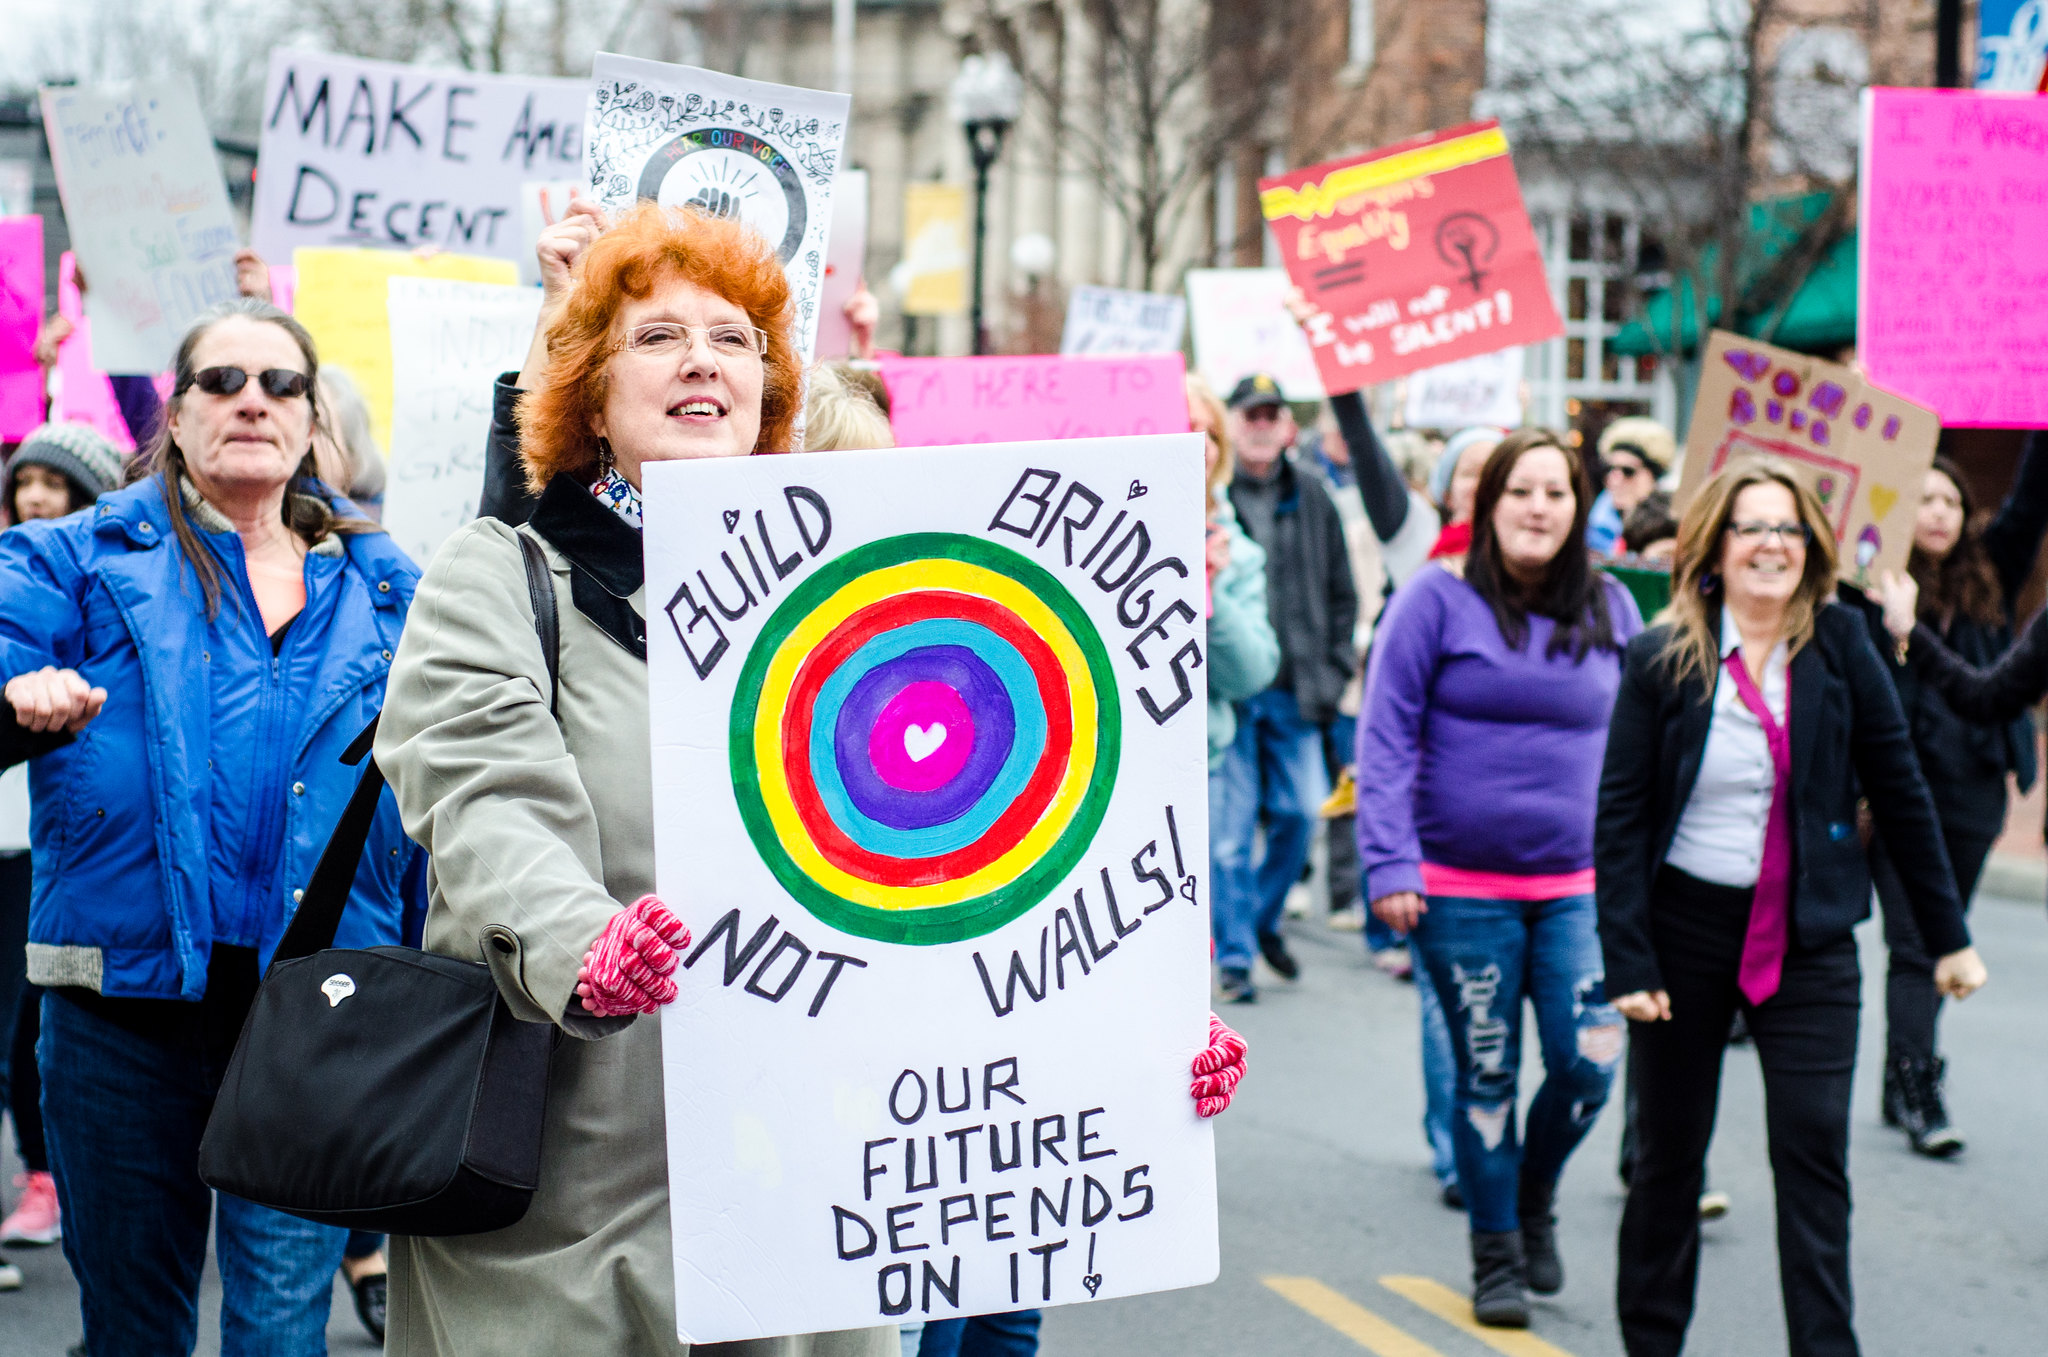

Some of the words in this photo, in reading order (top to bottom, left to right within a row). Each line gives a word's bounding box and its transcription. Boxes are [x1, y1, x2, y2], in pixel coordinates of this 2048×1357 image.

[269, 68, 478, 162] MAKE
[664, 132, 705, 161] HEAR
[710, 129, 745, 150] OUR
[751, 139, 789, 177] VOICE
[286, 164, 509, 247] DECENT
[1297, 207, 1411, 264] Equality
[1305, 312, 1338, 348] I
[1344, 299, 1401, 335] will
[1407, 284, 1450, 315] not
[1334, 339, 1375, 367] be
[1389, 288, 1514, 356] SILENT!
[972, 364, 1067, 409] HERE
[1102, 364, 1154, 398] TO
[683, 907, 868, 1018] NOT
[972, 805, 1198, 1018] WALLS!
[888, 1056, 1027, 1126] OUR
[863, 1106, 1119, 1201] FUTURE
[831, 1164, 1154, 1262] DEPENDS
[877, 1254, 961, 1317] ON
